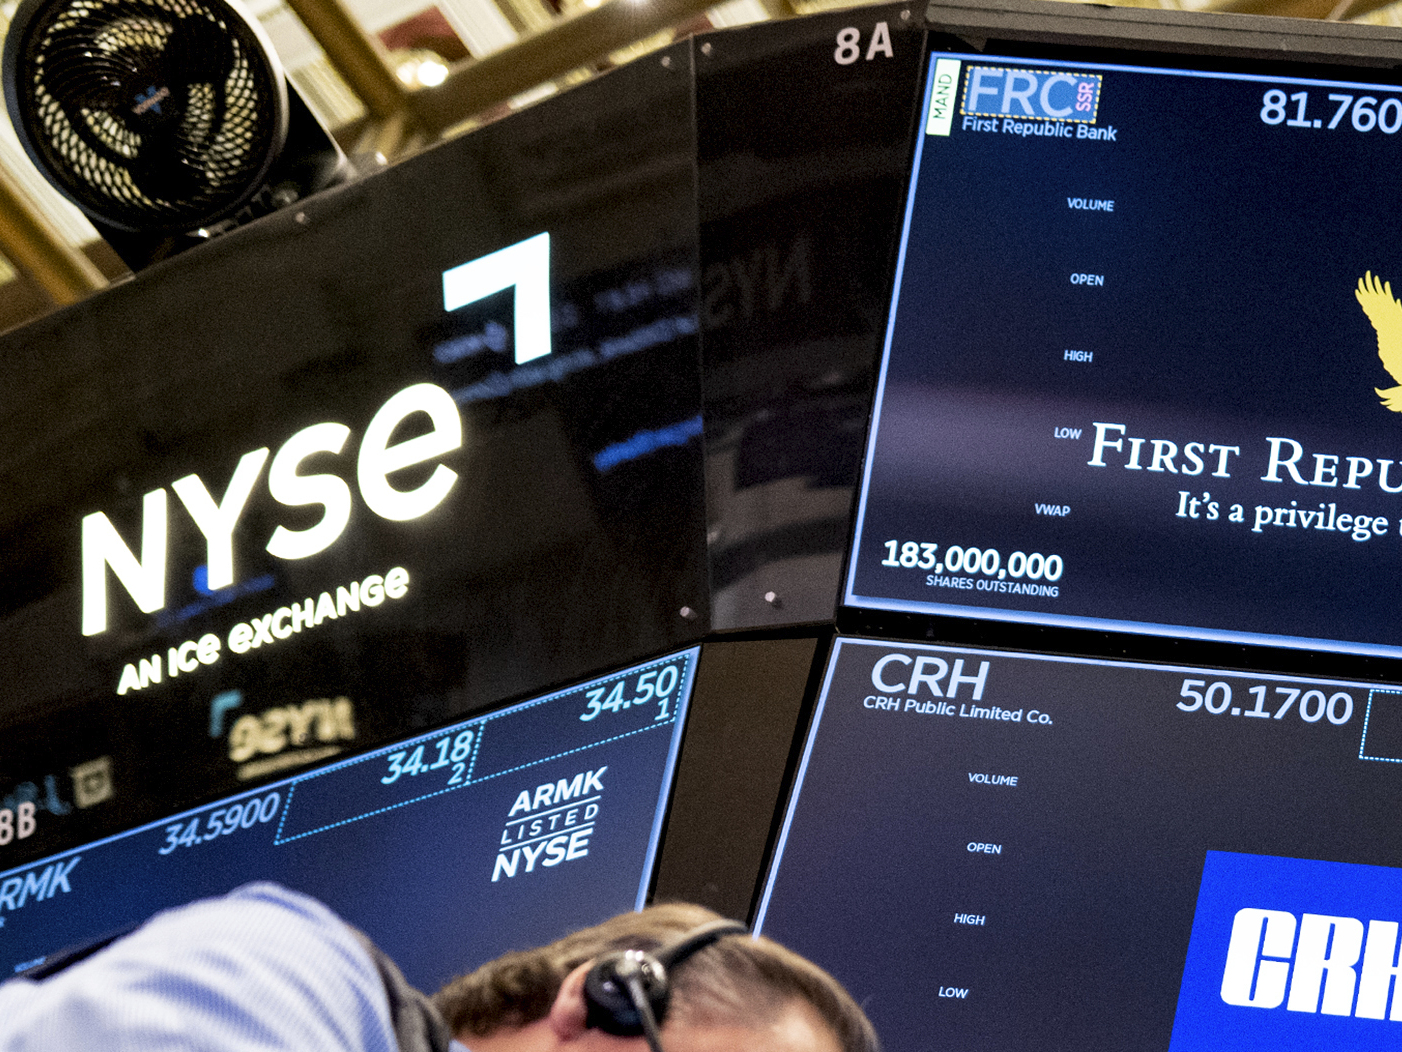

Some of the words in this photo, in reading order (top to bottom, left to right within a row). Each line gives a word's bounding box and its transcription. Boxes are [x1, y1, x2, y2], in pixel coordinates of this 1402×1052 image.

[834, 22, 894, 65] 8A
[933, 73, 953, 119] MAND
[968, 67, 1078, 118] FRC
[1075, 82, 1095, 112] SSR
[962, 116, 999, 132] First
[1002, 118, 1073, 138] Republic
[1076, 124, 1117, 141] Bank
[1066, 197, 1115, 212] VOLUME
[1069, 273, 1104, 287] OPEN
[1063, 350, 1093, 363] HIGH
[1054, 427, 1082, 440] LOW
[1034, 503, 1071, 517] VWAP
[1227, 502, 1244, 523] a
[1251, 500, 1388, 541] privilege
[881, 540, 1063, 581] 183,000,000
[925, 574, 974, 590] SHARES
[976, 579, 1059, 597] OUTSTANDING
[116, 654, 162, 695] AN
[871, 653, 990, 701] CRH
[579, 665, 678, 722] 34.50
[653, 698, 669, 722] 1
[863, 695, 900, 712] CRH
[904, 698, 955, 717] Public
[959, 704, 1023, 723] Limited
[1026, 709, 1053, 725] Co.
[1176, 678, 1354, 726] 50.1700
[381, 730, 474, 784] 34.18
[447, 762, 466, 785] 2
[508, 766, 607, 817] ARMK
[967, 772, 1019, 787] VOLUME
[159, 791, 280, 856] 34.5900
[501, 804, 599, 845] LISTED
[491, 827, 594, 882] NYSE
[966, 842, 1002, 855] OPEN
[0, 856, 81, 910] RMK
[953, 912, 986, 926] HIGH
[938, 986, 969, 999] LOW
